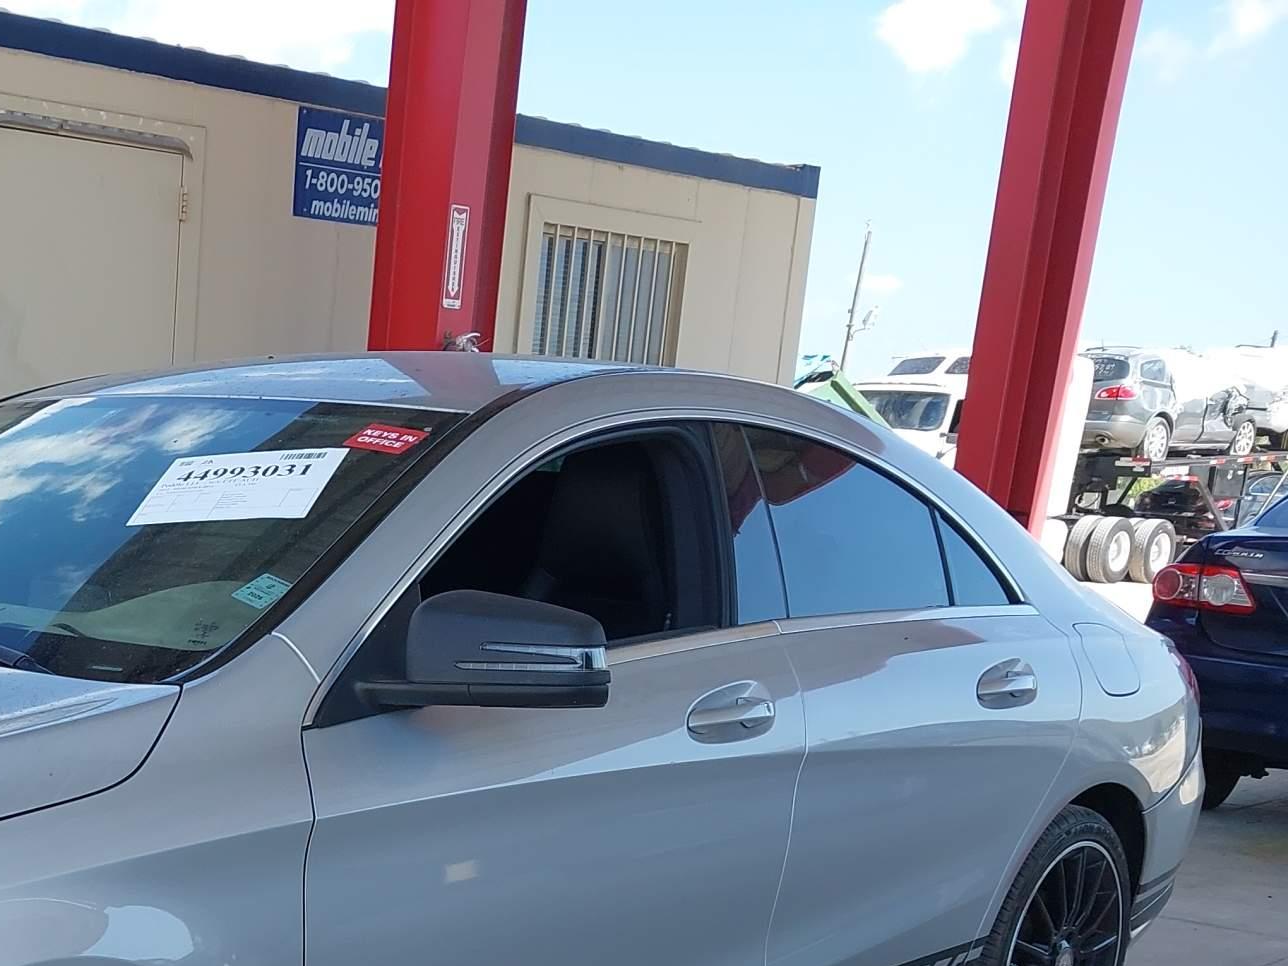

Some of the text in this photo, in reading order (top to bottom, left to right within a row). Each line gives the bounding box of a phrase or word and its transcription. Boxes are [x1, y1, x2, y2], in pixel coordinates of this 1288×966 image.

[300, 119, 379, 167] mobile
[357, 436, 405, 448] OFFICE
[363, 428, 418, 443] KEYS IN
[176, 463, 313, 482] 44993031
